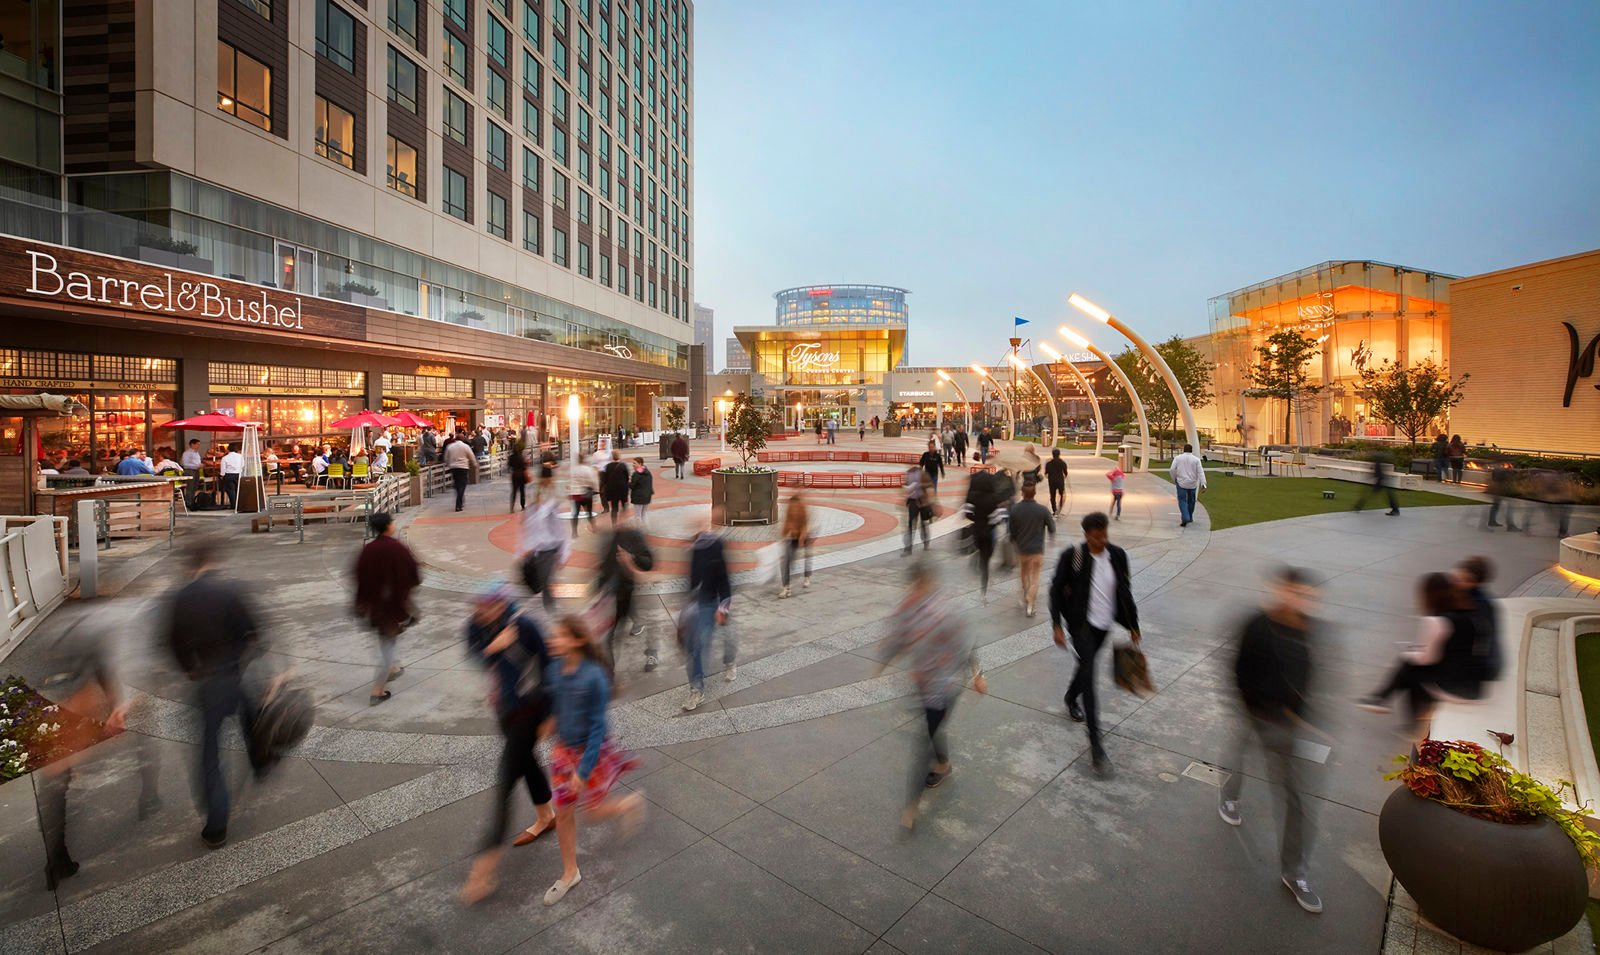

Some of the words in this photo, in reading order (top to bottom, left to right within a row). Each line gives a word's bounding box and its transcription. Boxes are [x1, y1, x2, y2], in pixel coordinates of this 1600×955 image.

[786, 342, 840, 369] Tysons
[3, 379, 33, 387] HAND
[34, 380, 75, 388] CRAFTED
